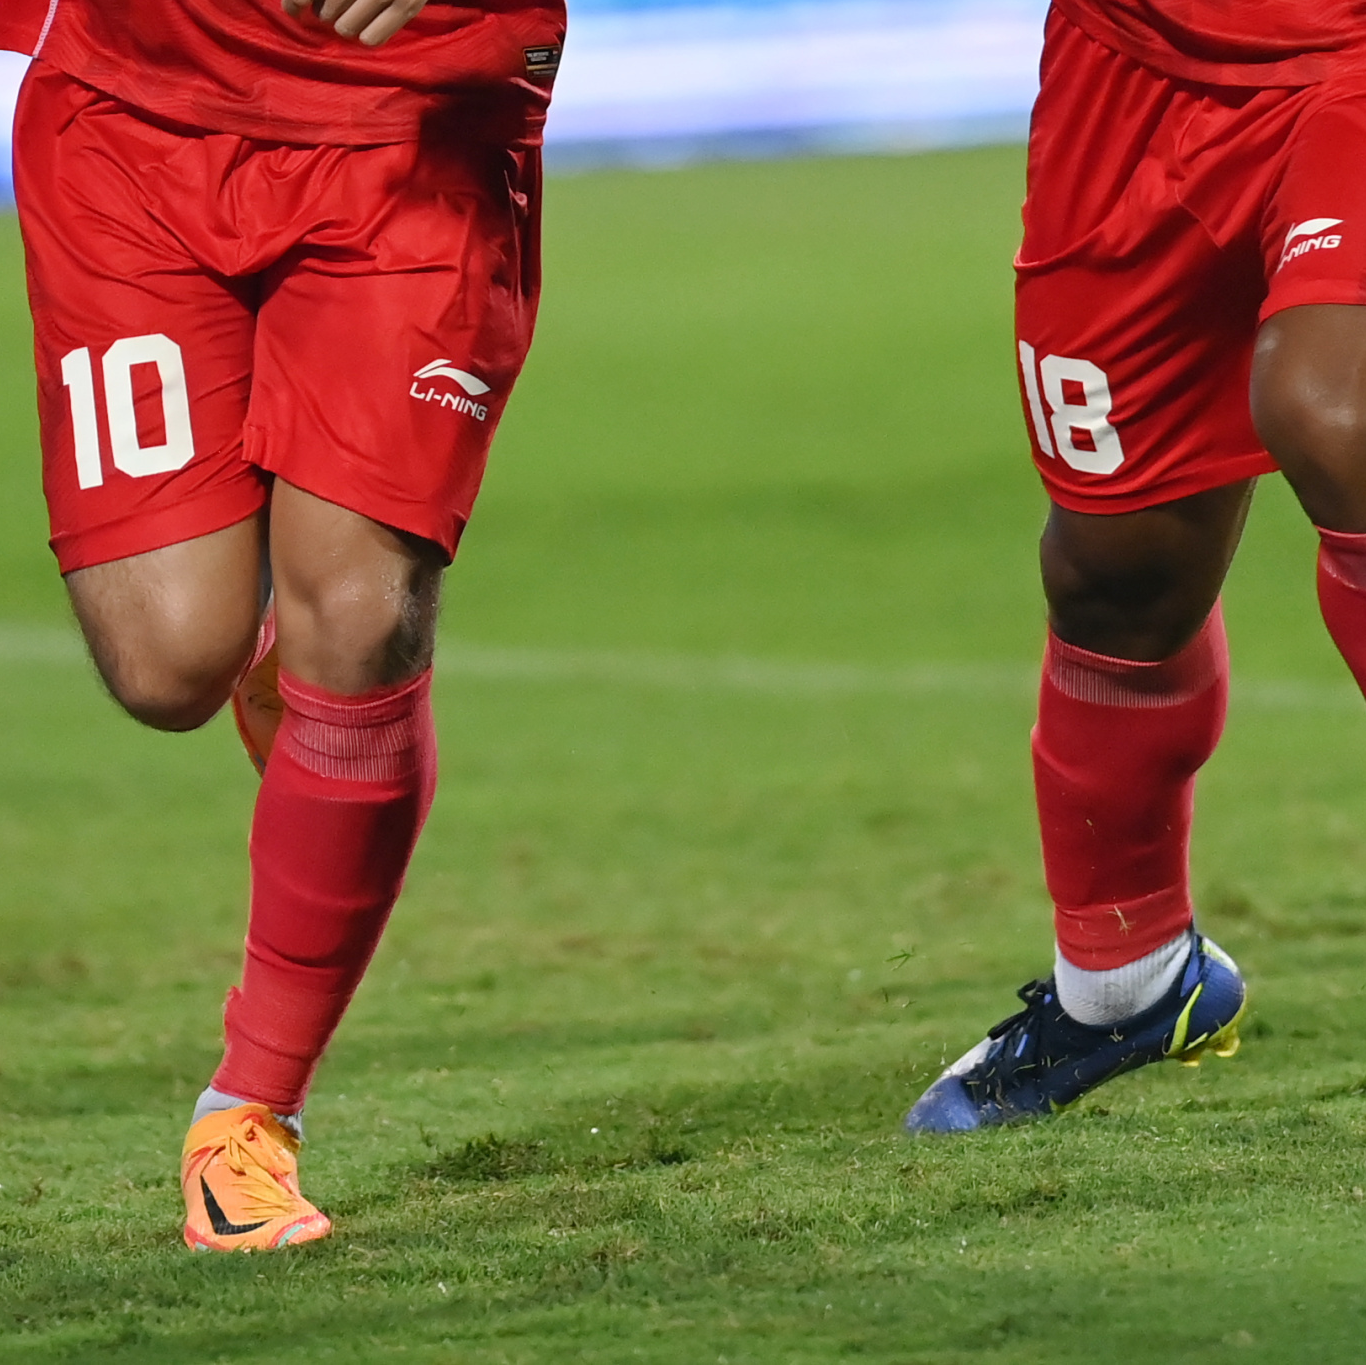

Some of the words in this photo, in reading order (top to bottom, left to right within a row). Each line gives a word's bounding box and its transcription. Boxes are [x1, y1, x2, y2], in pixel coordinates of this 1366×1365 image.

[60, 332, 196, 491] 10
[409, 381, 489, 422] LI-NING
[1018, 339, 1126, 475] 18
